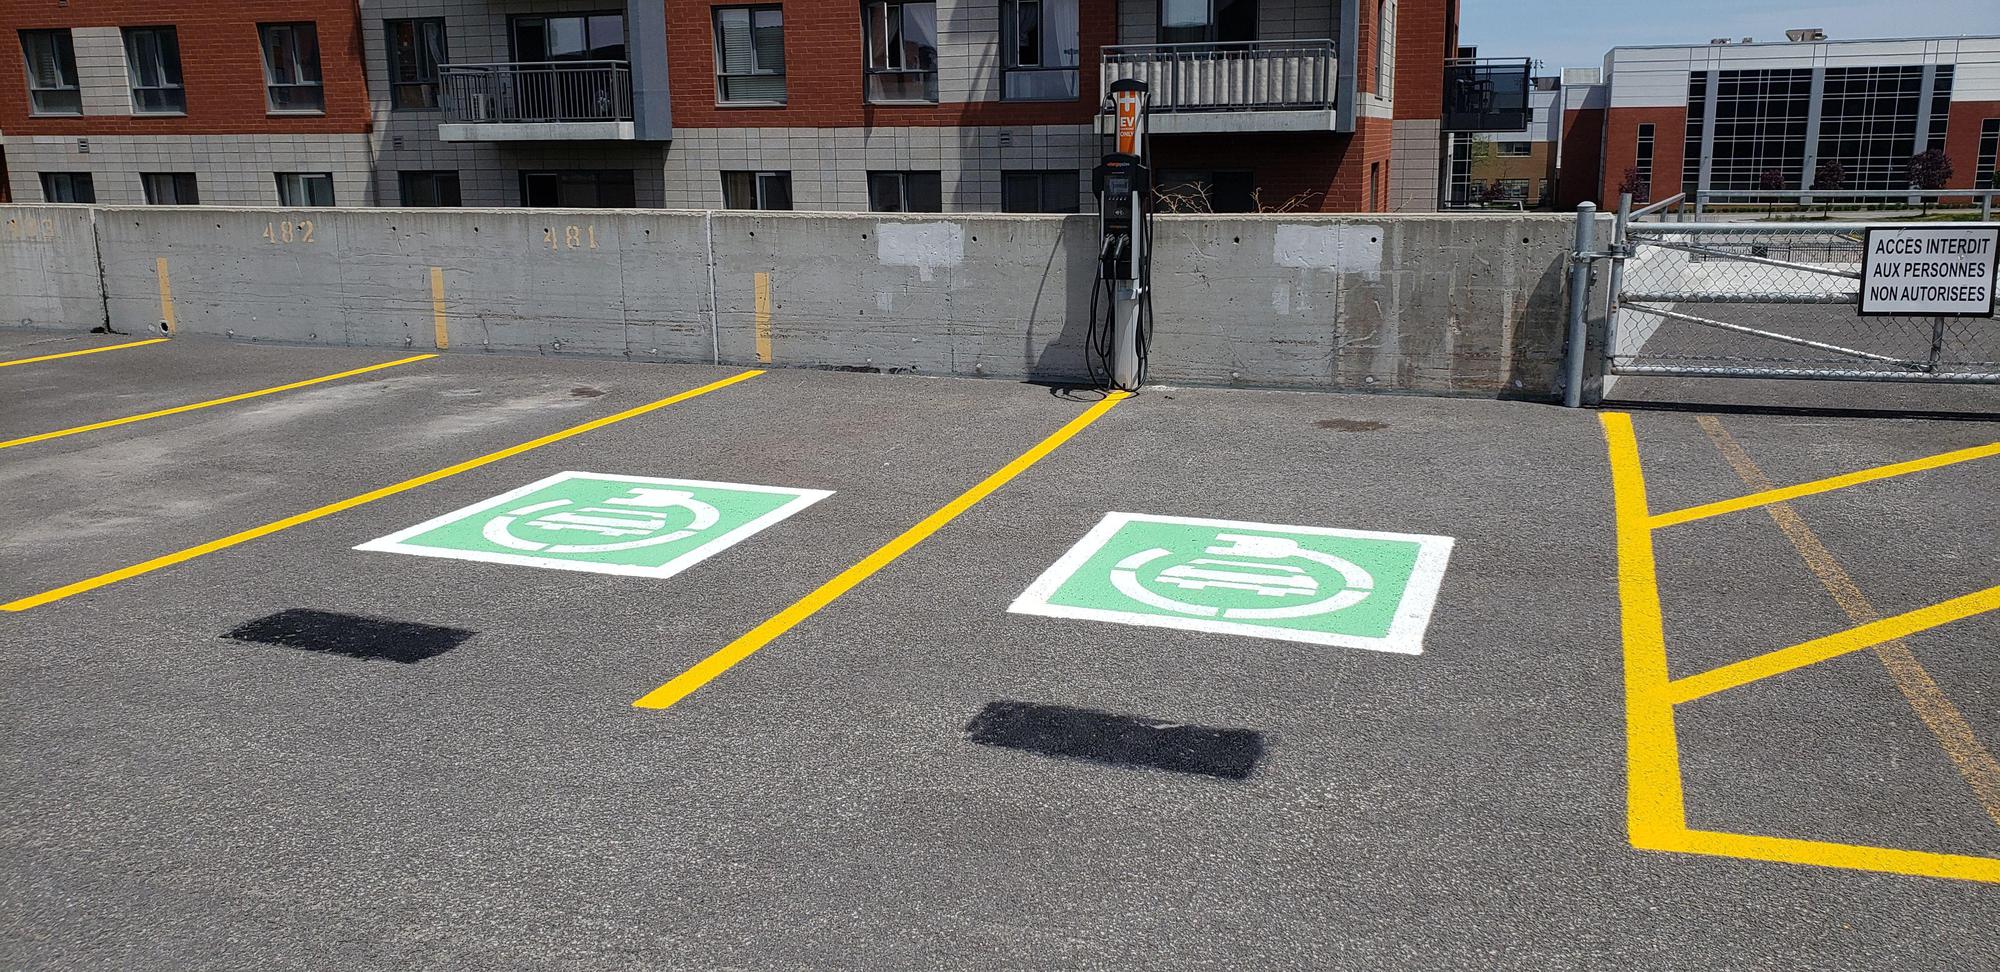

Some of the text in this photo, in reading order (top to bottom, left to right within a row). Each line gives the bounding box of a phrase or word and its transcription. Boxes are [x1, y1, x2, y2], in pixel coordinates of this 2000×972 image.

[1120, 116, 1134, 127] EV
[263, 220, 314, 244] 482
[543, 223, 600, 251] 481
[1926, 238, 1990, 254] INTERDIT
[1873, 262, 1986, 278] AUX PERSONNES
[1870, 286, 1898, 301] NON
